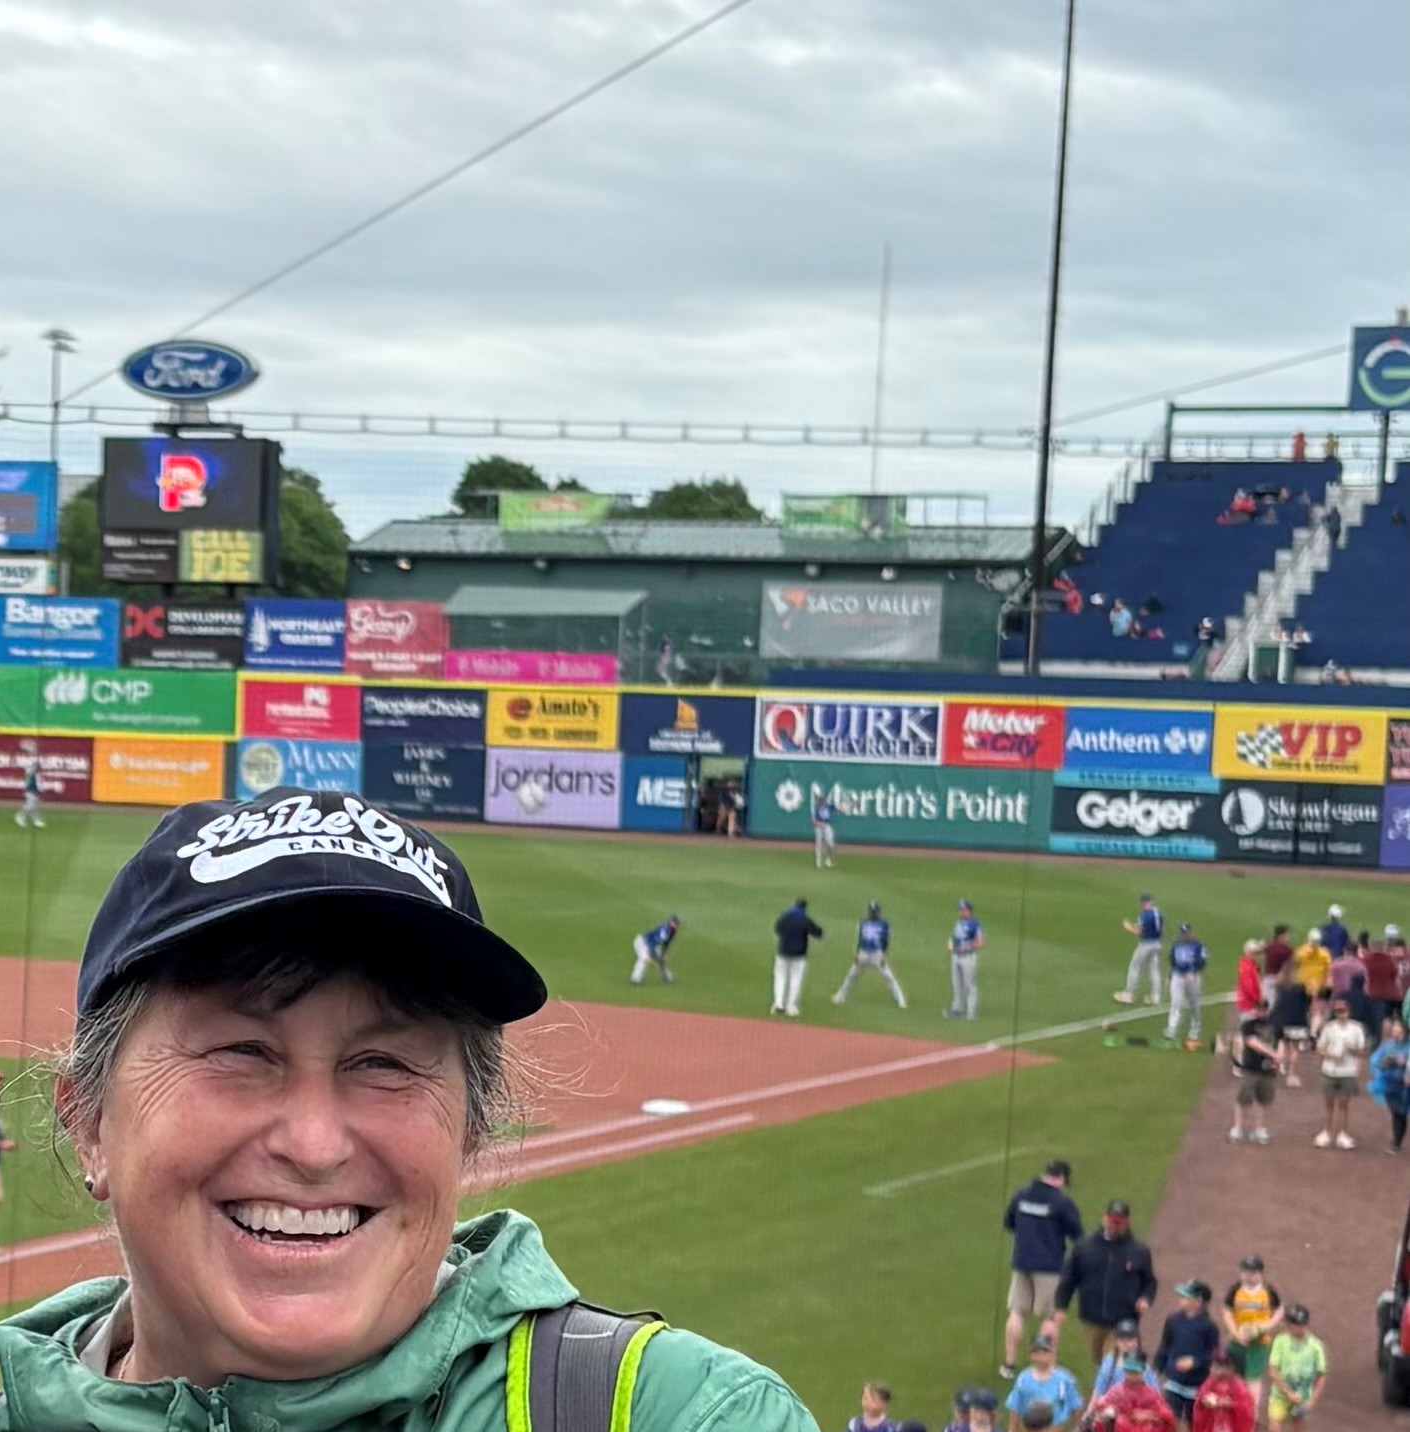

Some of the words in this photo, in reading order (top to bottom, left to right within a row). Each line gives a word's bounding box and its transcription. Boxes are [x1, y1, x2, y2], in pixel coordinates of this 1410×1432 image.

[143, 351, 228, 389] Ford
[5, 597, 100, 629] Bangor
[808, 595, 860, 613] SACO
[866, 595, 932, 616] VALLEY
[92, 680, 151, 704] CMP
[538, 696, 600, 719] Amato's
[764, 703, 935, 751] QUIRK
[963, 707, 1045, 736] Motor
[1065, 727, 1161, 755] Anthem
[1278, 720, 1363, 762] VIP
[490, 759, 615, 797] jordan's
[810, 780, 939, 820] Martin's
[946, 785, 1029, 826] Point
[1076, 790, 1196, 837] Geiger
[176, 795, 355, 858] Strike
[343, 797, 448, 884] Out
[288, 836, 399, 868] CANCER
